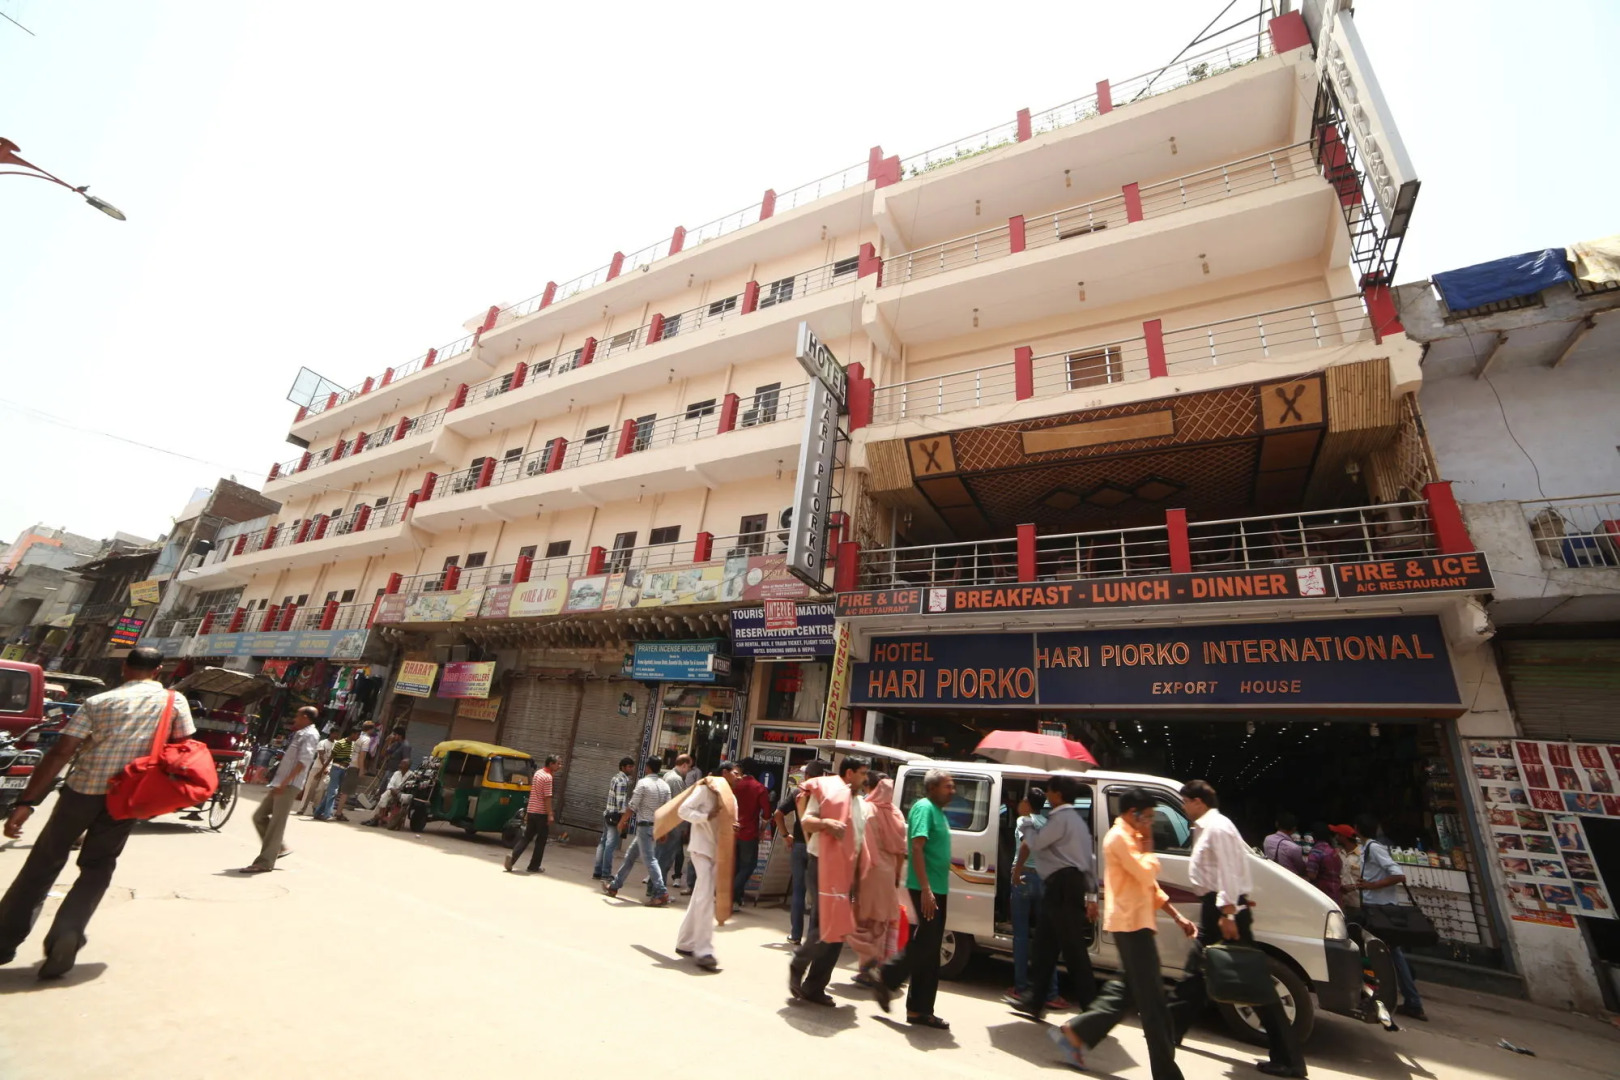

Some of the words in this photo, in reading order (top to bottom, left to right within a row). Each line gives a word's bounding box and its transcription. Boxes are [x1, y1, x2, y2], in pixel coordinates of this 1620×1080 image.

[807, 330, 846, 400] HOTEL
[819, 391, 832, 454] HARI
[805, 462, 824, 568] PIORKO
[1340, 562, 1397, 582] FIRE
[1405, 560, 1425, 577] &
[1432, 556, 1481, 576] ICE
[954, 585, 1073, 609] BREAKFAST
[1092, 580, 1170, 603] LUNCH
[1191, 574, 1288, 598] DINNER
[1356, 582, 1377, 592] A/C
[1380, 577, 1468, 591] RESTAURANT
[520, 589, 535, 603] FIRE
[537, 589, 542, 602] &
[544, 588, 558, 602] ICE
[839, 593, 872, 607] FIRE
[876, 592, 888, 604] &
[892, 590, 918, 604] ICE
[733, 609, 765, 619] TOURIS
[858, 605, 910, 615] RESTAURANT
[735, 627, 795, 638] RESERVATION
[796, 625, 834, 635] CENTRE
[836, 628, 849, 677] MONEY
[874, 642, 934, 662] HOTEL
[1036, 646, 1089, 669] HARI
[1101, 641, 1190, 667] PIORKO
[1203, 634, 1434, 664] INTERNATIONAL
[404, 662, 434, 676] BHARAT
[868, 668, 925, 699] HARI
[937, 667, 1035, 699] PIORKO
[1151, 681, 1218, 694] EXPORT
[1240, 680, 1302, 693] HOUSE
